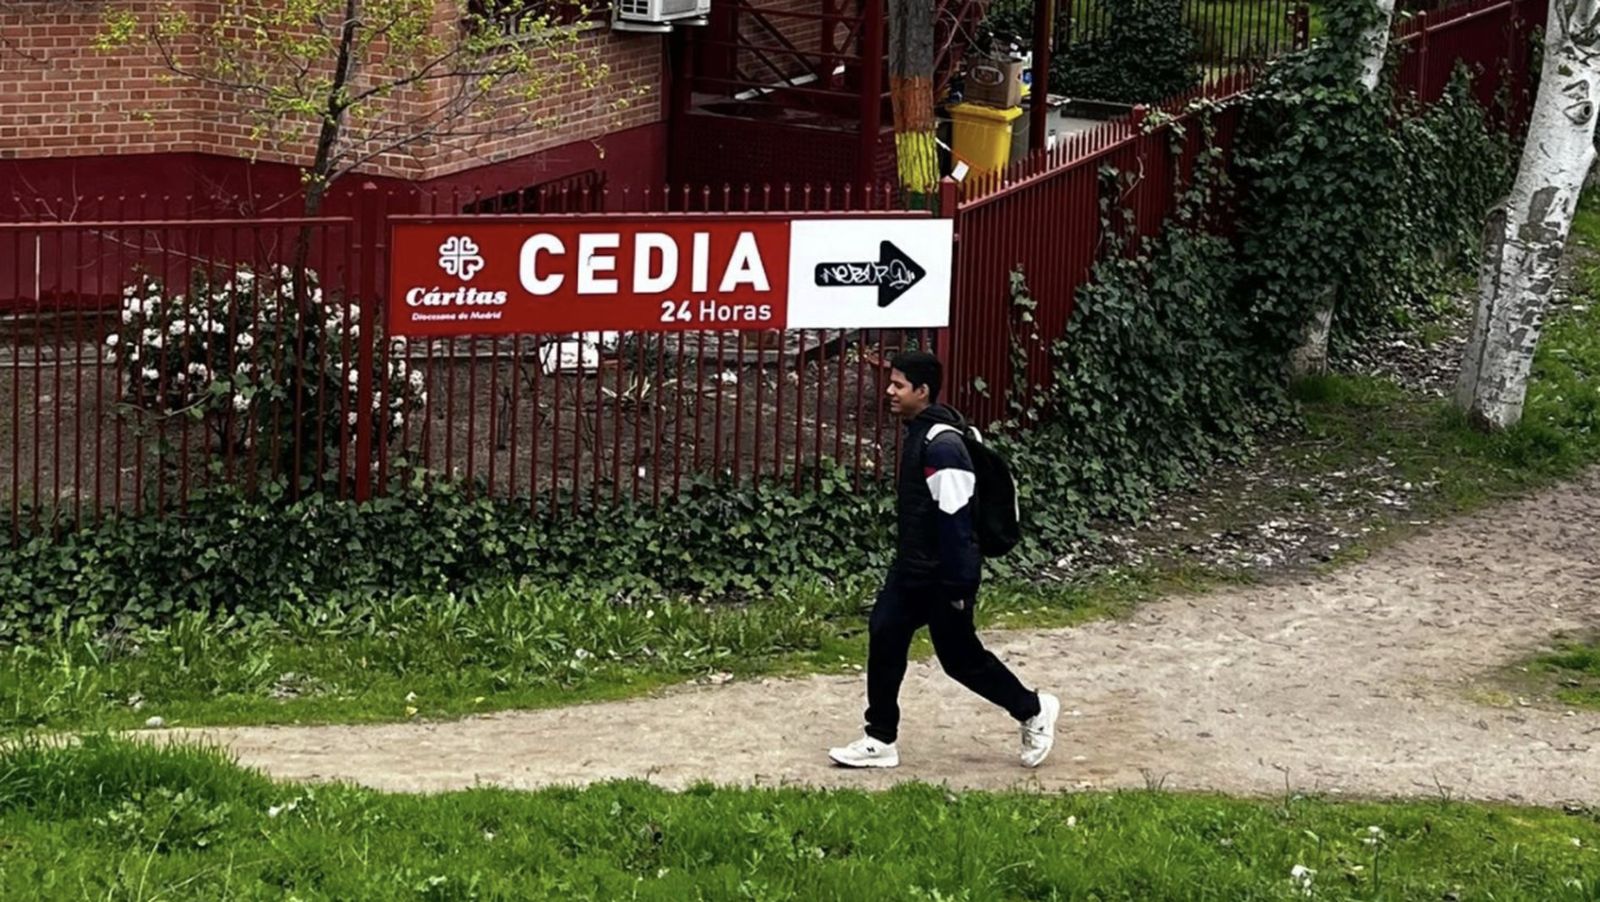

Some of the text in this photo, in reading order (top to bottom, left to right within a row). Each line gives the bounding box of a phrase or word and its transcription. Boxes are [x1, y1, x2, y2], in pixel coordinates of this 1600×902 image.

[518, 231, 771, 296] CEDIA
[405, 286, 508, 307] Cáritas
[411, 311, 502, 321] Diocesana de Madrid
[660, 299, 772, 322] 24 Horas
